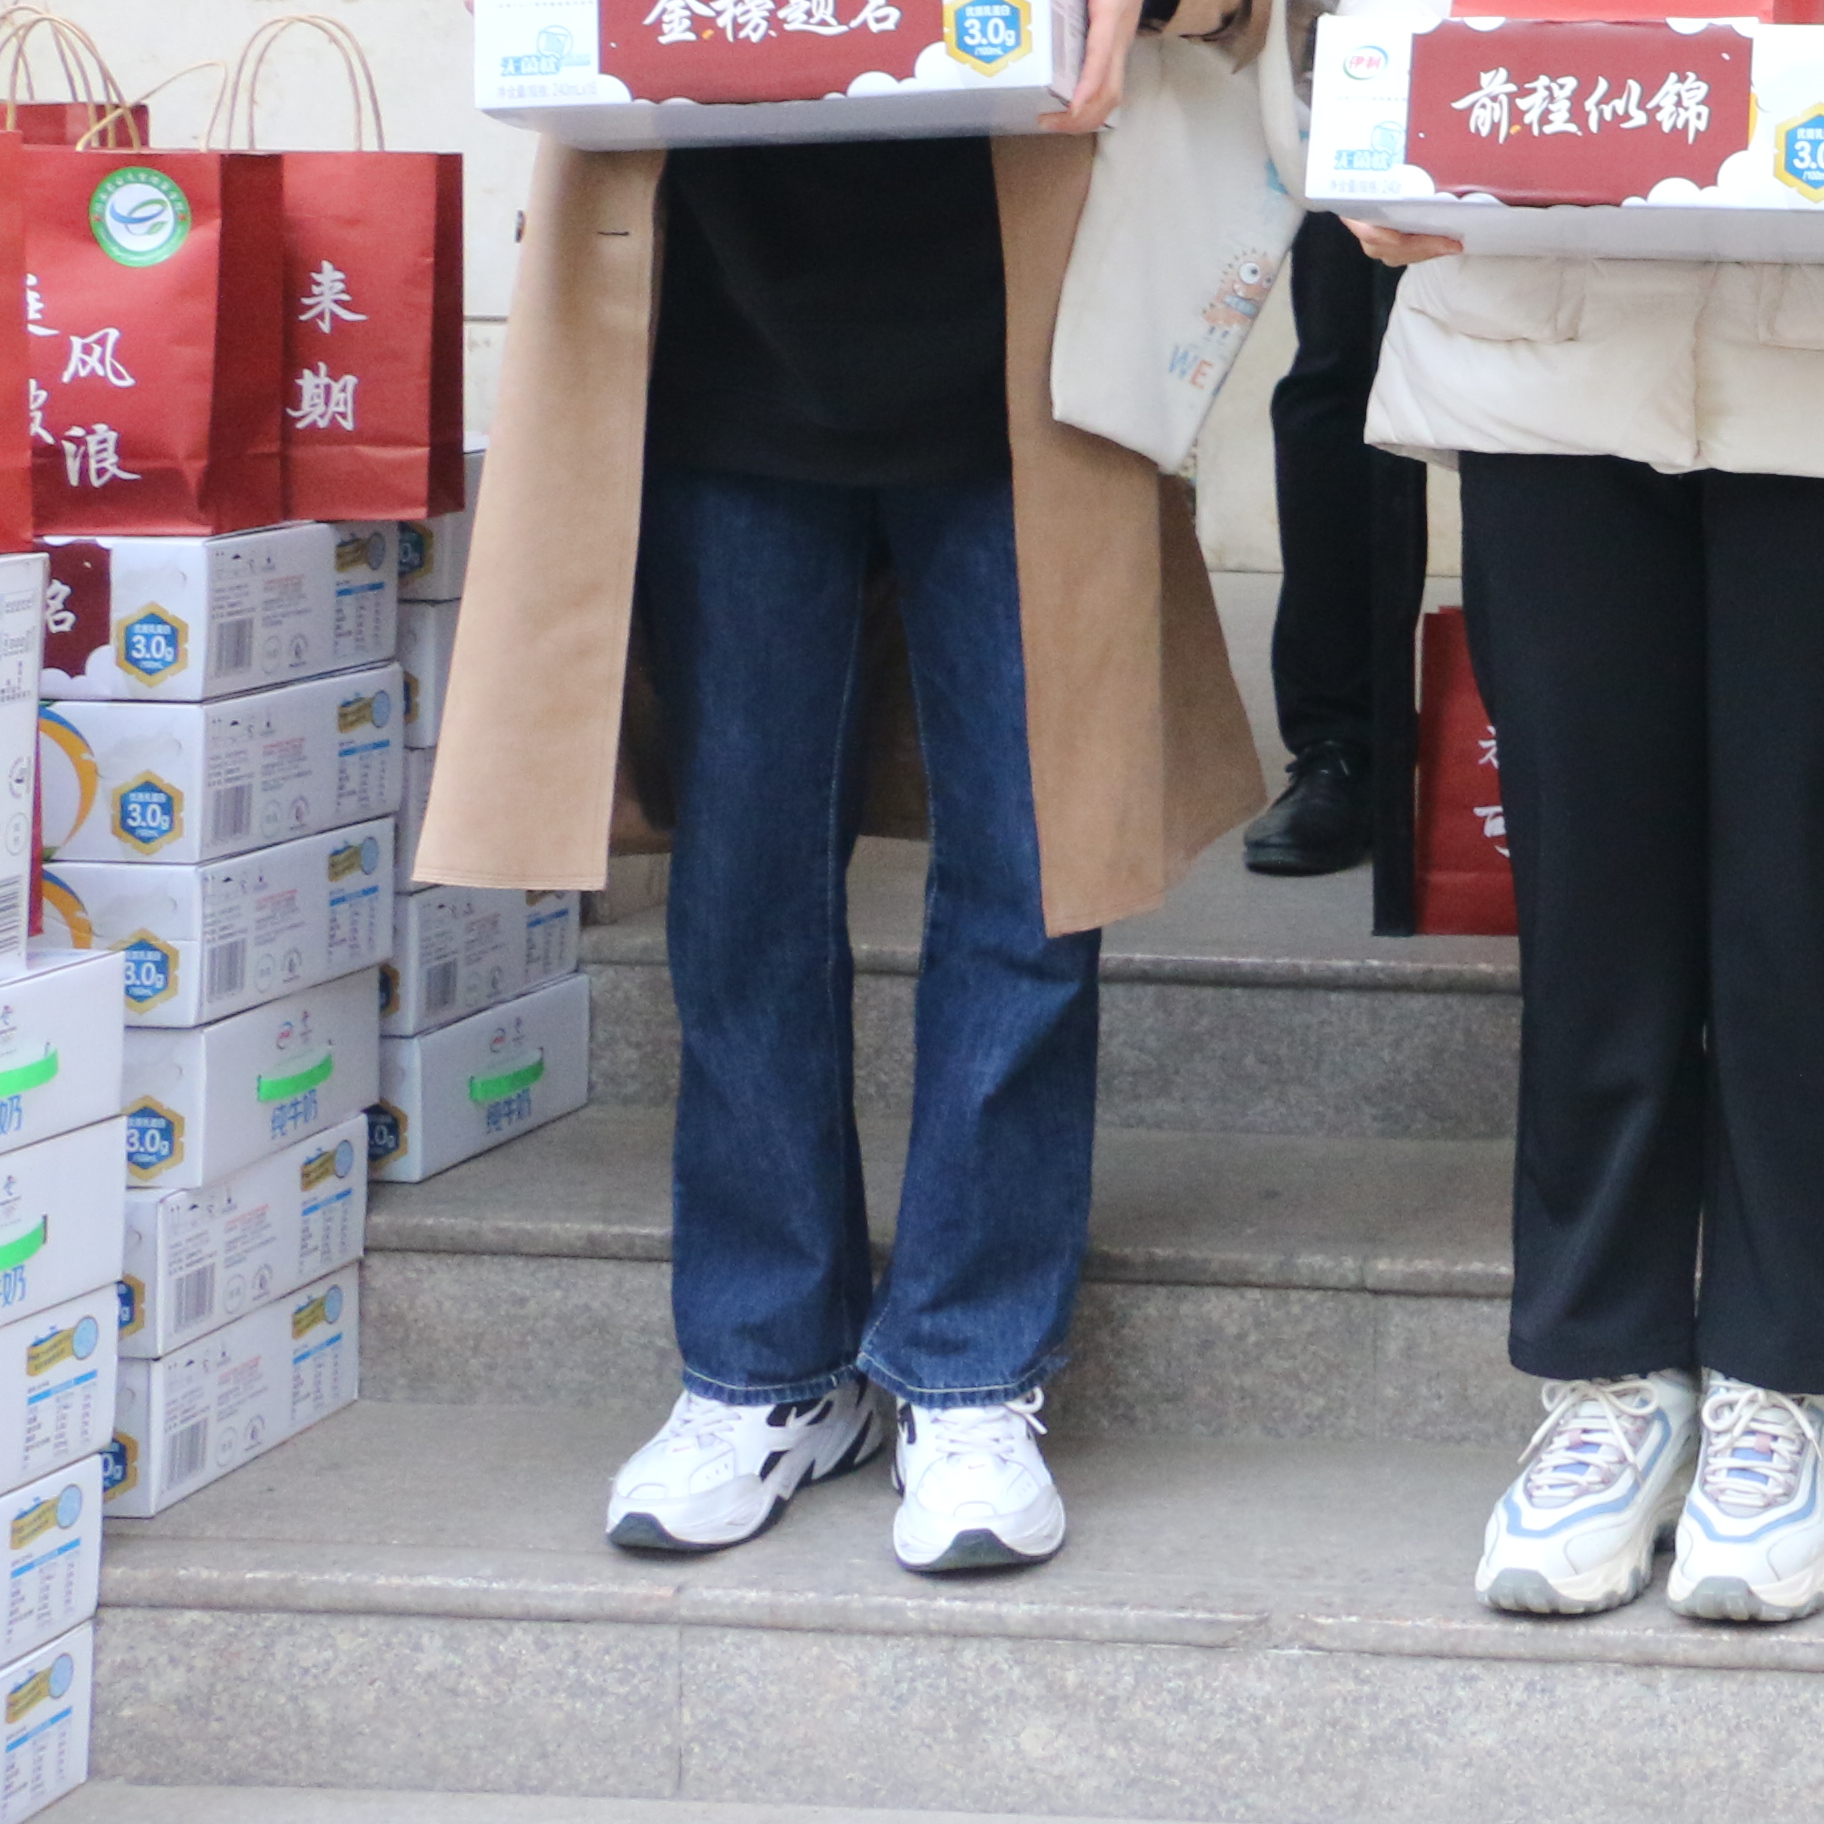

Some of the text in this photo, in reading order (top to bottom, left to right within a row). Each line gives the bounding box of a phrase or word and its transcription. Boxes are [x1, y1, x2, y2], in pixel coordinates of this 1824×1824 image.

[963, 17, 1016, 46] 3.0g
[1450, 67, 1711, 144] 前程似锦
[131, 635, 175, 663] 3.0g
[126, 803, 171, 830] 3.0g
[124, 960, 165, 987] 3.0g
[270, 1094, 319, 1140] 纯牛奶
[486, 1087, 533, 1134] 纯牛奶
[125, 1128, 170, 1156] 3.0g
